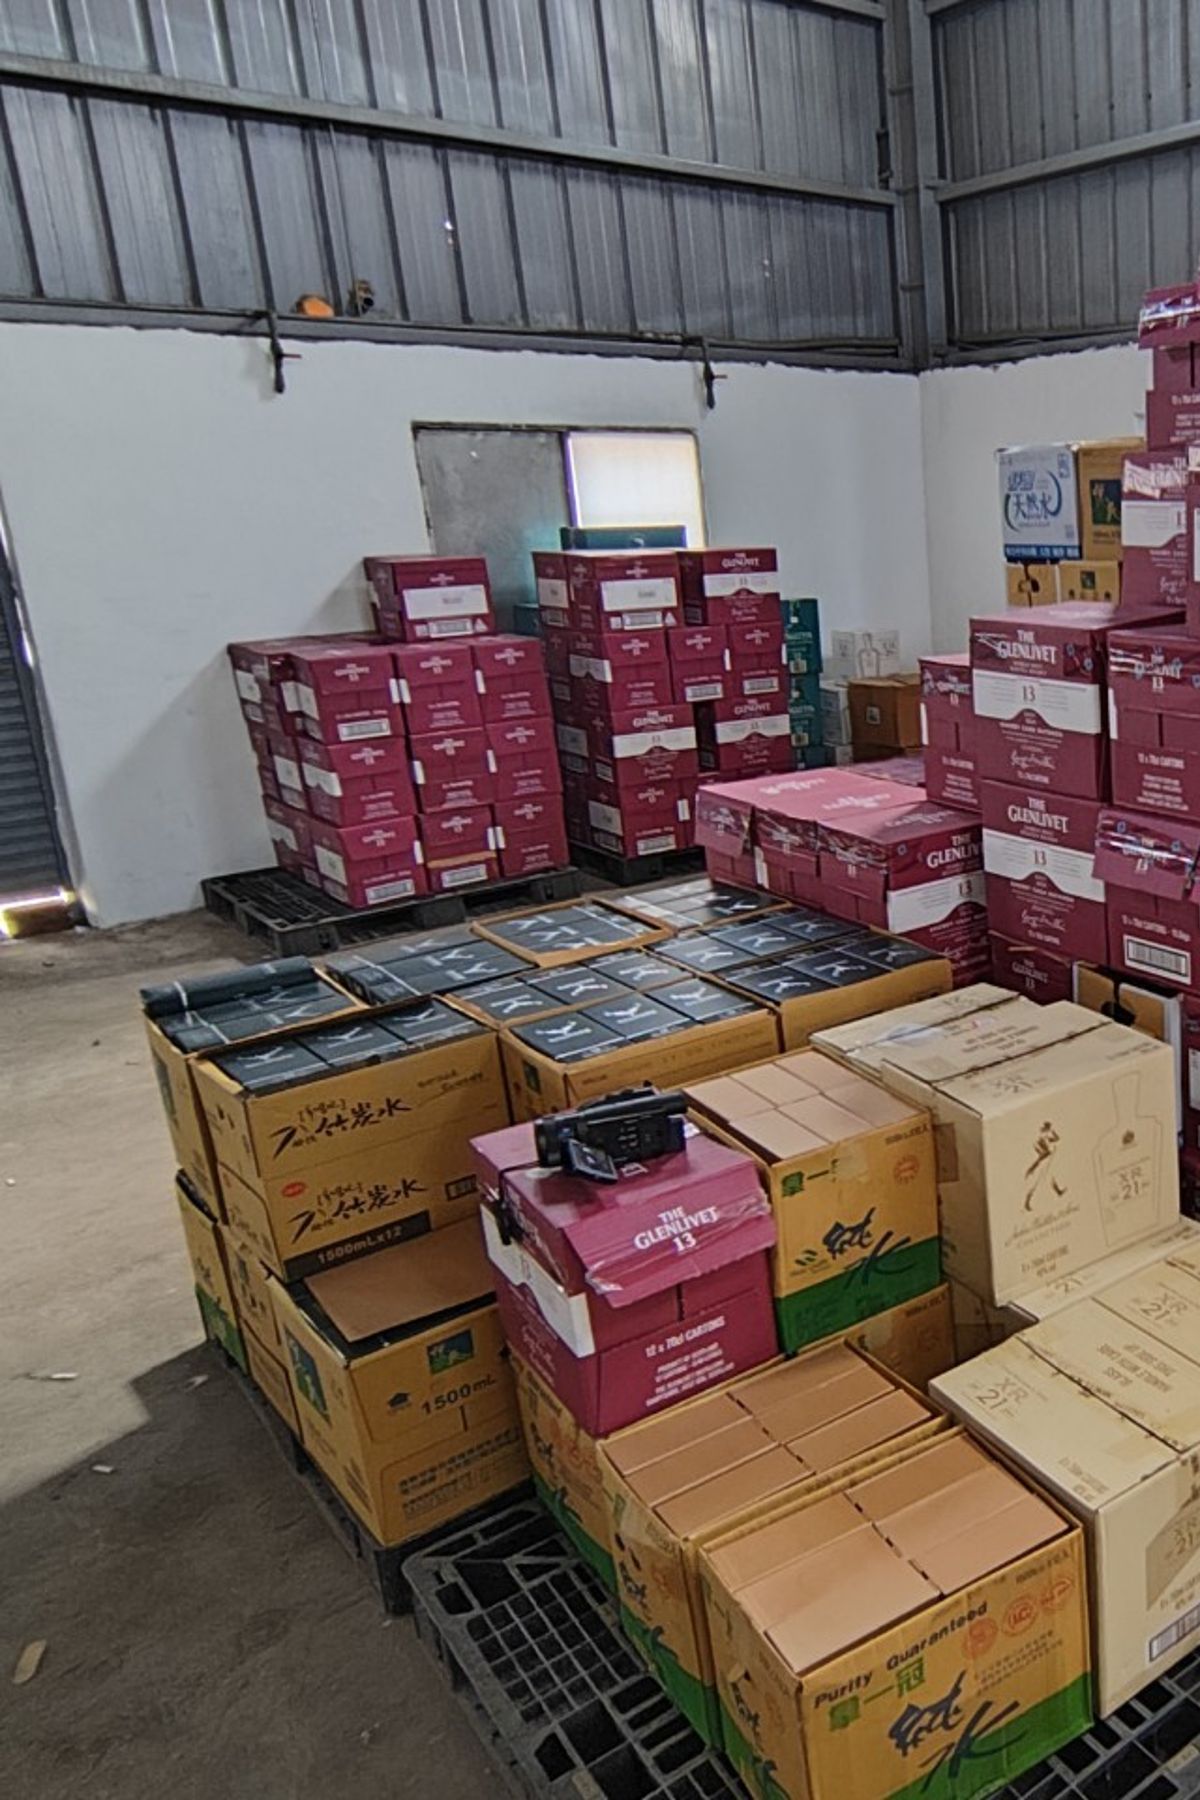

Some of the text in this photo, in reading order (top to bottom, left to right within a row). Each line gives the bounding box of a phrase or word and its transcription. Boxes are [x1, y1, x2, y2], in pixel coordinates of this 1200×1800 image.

[998, 640, 1058, 665] GLENLIVET
[1022, 685, 1036, 701] 13
[1028, 796, 1046, 812] THE
[1007, 805, 1069, 833] GLENLIVET
[926, 840, 981, 869] GLENLIV
[657, 1205, 686, 1224] THE
[633, 1205, 720, 1251] GLENLIVET
[673, 1232, 697, 1252] 13
[1140, 1301, 1171, 1322] 21
[974, 1388, 1008, 1412] 21
[813, 1670, 874, 1710] Purity
[886, 1600, 990, 1672] Guaranteed
[828, 1655, 926, 1733] 一冠
